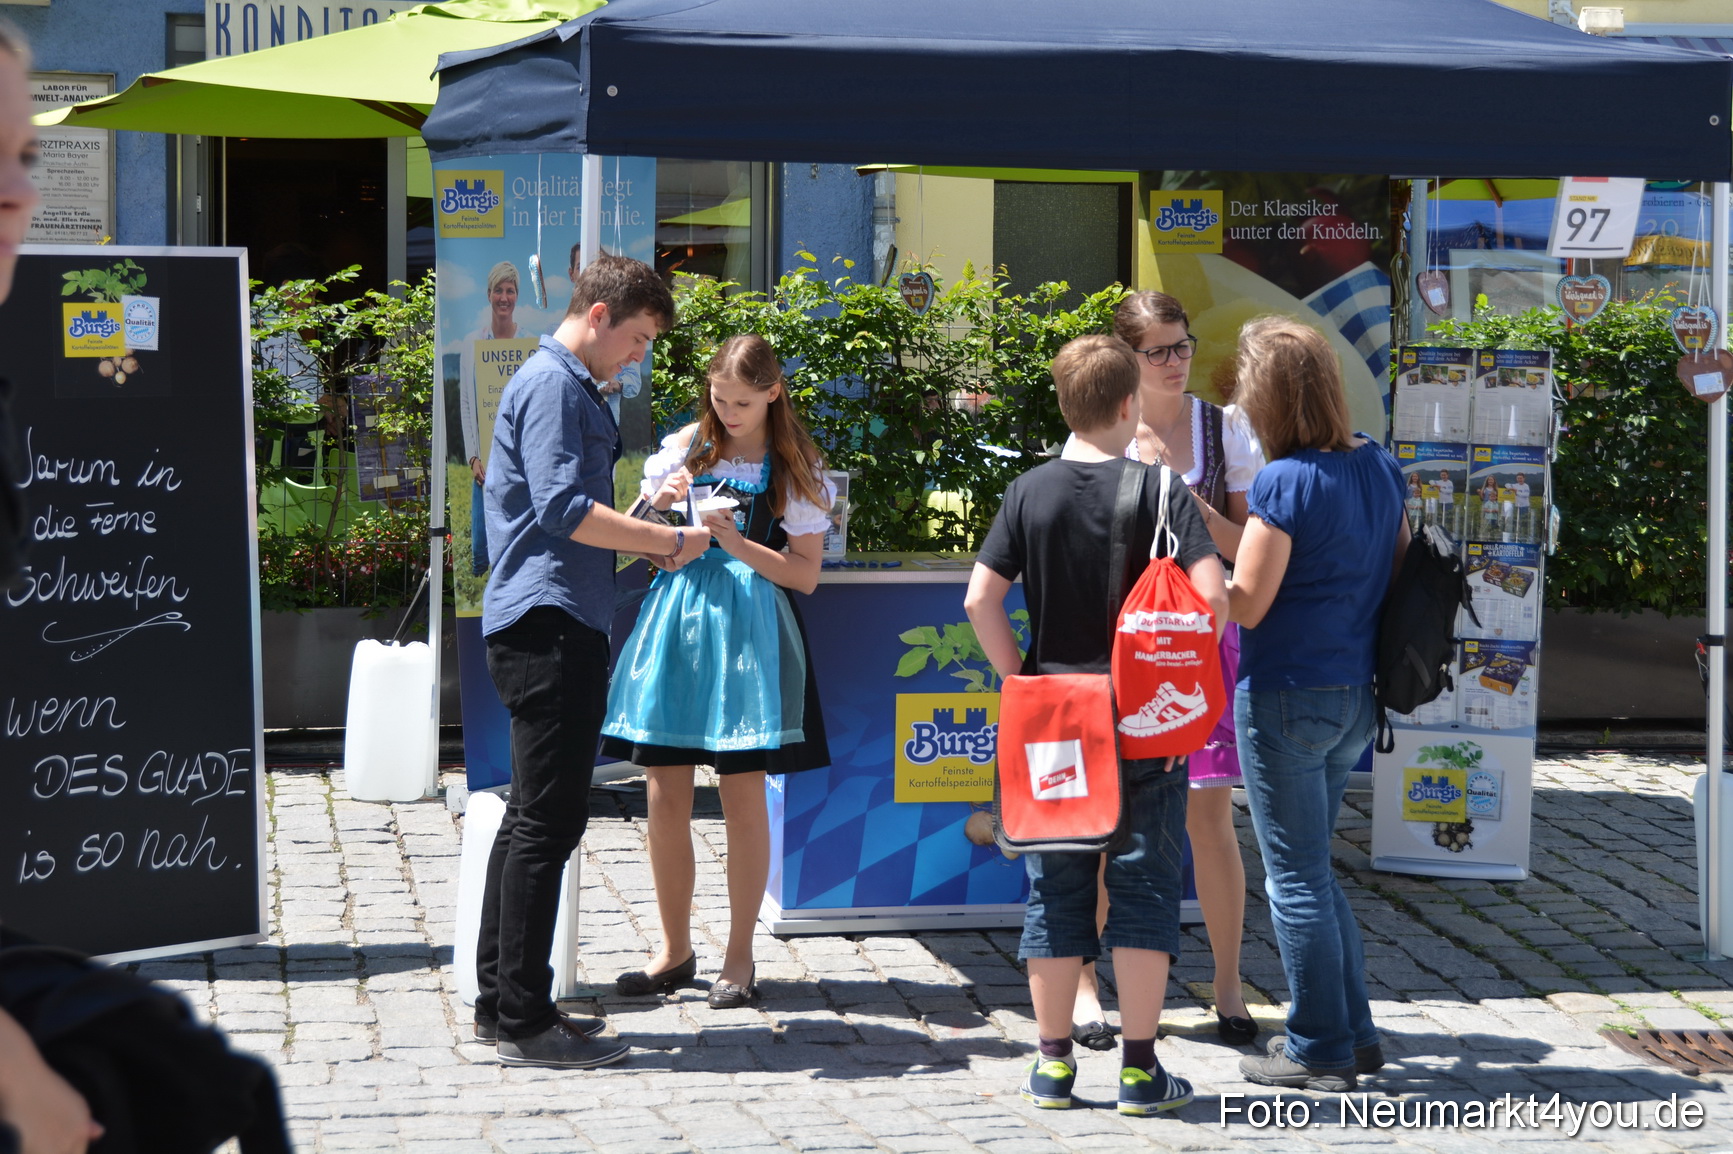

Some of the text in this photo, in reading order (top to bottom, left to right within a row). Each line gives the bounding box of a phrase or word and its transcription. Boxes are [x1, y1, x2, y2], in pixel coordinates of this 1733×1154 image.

[40, 140, 100, 151] RZTPRAXIS
[67, 152, 89, 160] Bayer
[512, 175, 634, 201] Qualitä iegt
[440, 187, 499, 215] Burgis
[1230, 199, 1339, 217] Der Klassiker
[1642, 196, 1685, 207] robieren
[512, 206, 645, 226] in der Fmilie.
[1155, 206, 1219, 232] Burgis
[1566, 207, 1611, 243] 97
[1230, 222, 1384, 240] unter den Knödeln.
[69, 317, 121, 338] Burgis
[125, 318, 155, 327] Qualität
[481, 349, 523, 363] UNSER
[137, 448, 182, 491] in
[34, 504, 78, 541] die
[1156, 637, 1172, 645] MIT
[7, 696, 127, 737] wenn
[904, 721, 998, 765] Burgi
[33, 748, 252, 806] DES GUADE
[942, 766, 974, 775] Feinste
[1407, 781, 1462, 804] Burgis
[1466, 788, 1497, 797] Qualität
[19, 814, 242, 884] is so nah.
